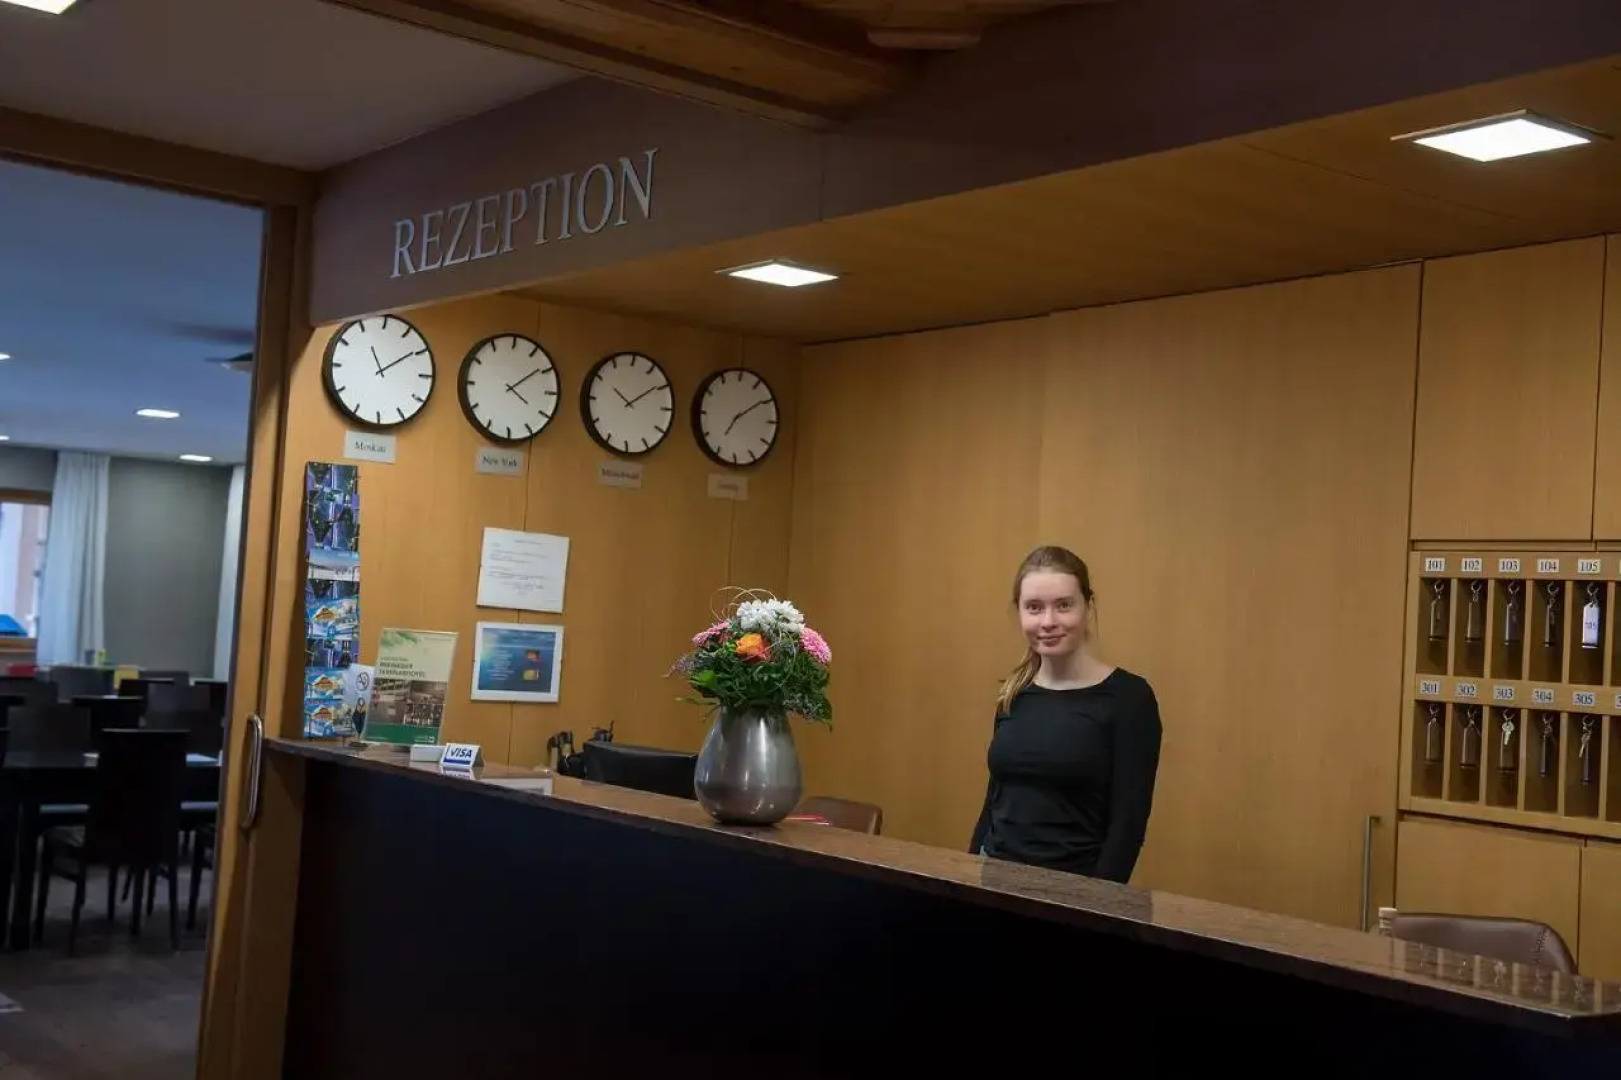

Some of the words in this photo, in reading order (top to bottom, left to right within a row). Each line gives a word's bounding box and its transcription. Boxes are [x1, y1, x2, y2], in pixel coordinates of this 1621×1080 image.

[390, 147, 658, 279] REZEPTION
[1427, 560, 1443, 570] 101
[1463, 560, 1480, 570] 102
[1501, 560, 1518, 571] 103
[1540, 561, 1557, 571] 104
[1580, 561, 1598, 572] 105
[1421, 683, 1438, 693] 301
[1458, 685, 1475, 696] 302
[1495, 688, 1513, 699] 303
[1534, 691, 1552, 701] 304
[1575, 694, 1593, 705] 305
[450, 748, 473, 758] VISA
